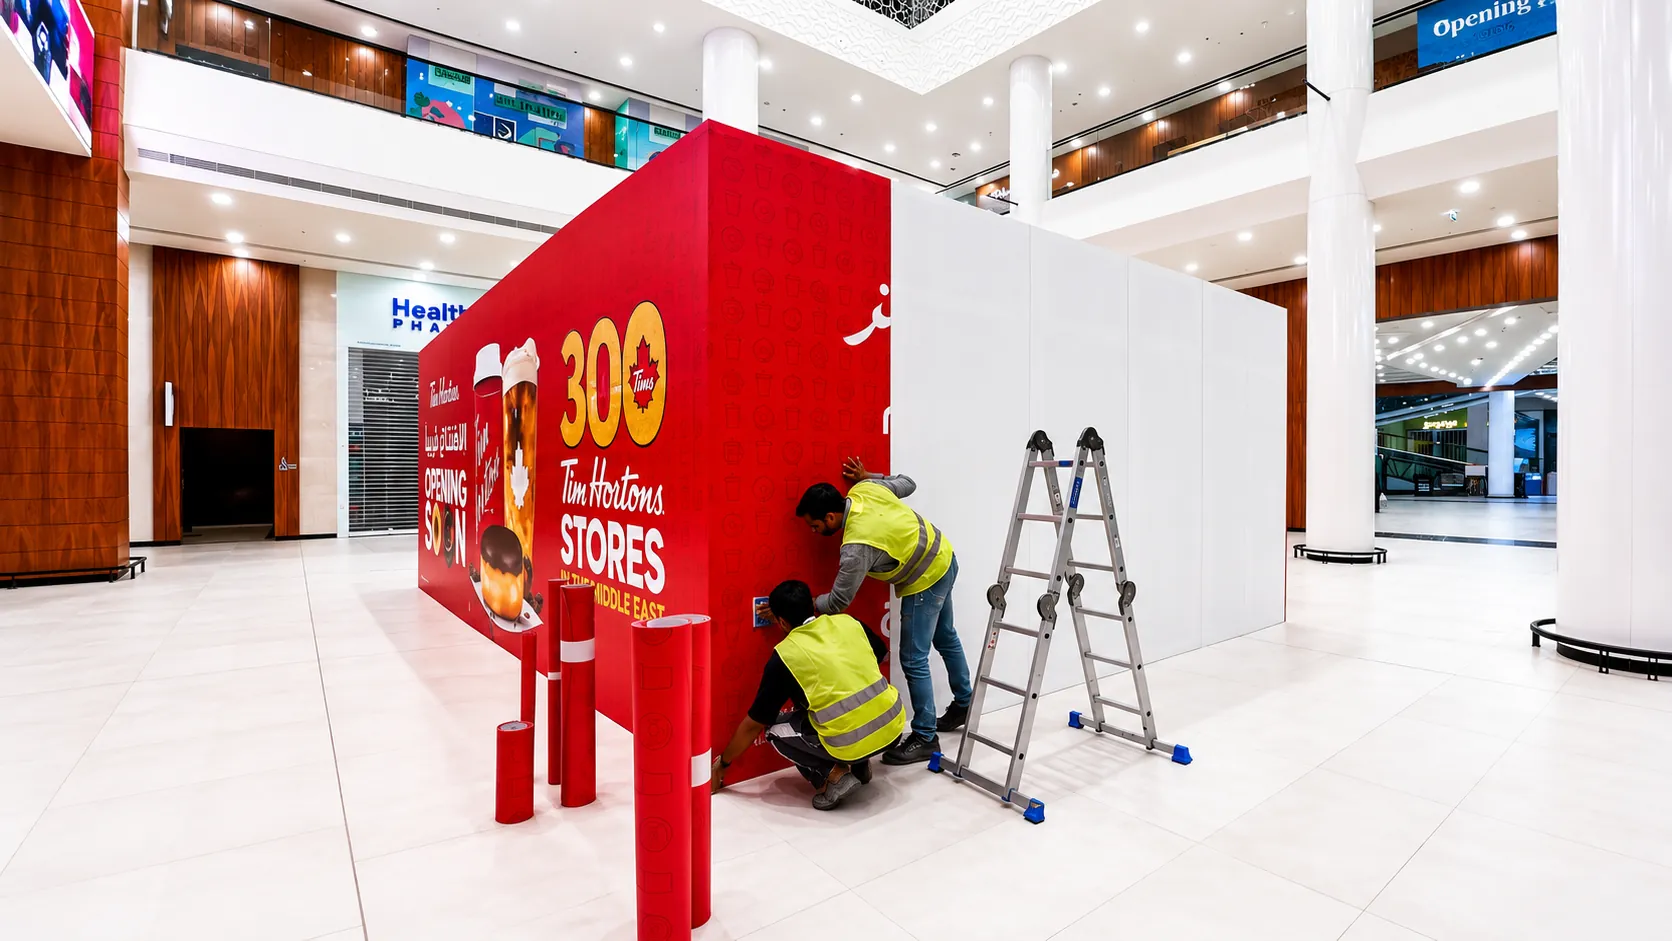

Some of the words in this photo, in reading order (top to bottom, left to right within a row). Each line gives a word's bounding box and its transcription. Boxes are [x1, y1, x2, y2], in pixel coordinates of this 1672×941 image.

[1433, 0, 1531, 38] Opening
[393, 318, 450, 333] PHA
[560, 300, 667, 449] 300
[633, 368, 654, 393] Tims
[425, 467, 467, 508] OPENING
[560, 458, 587, 506] Tim
[425, 500, 466, 568] SOON
[560, 513, 665, 595] STORES
[633, 595, 665, 621] EAST
